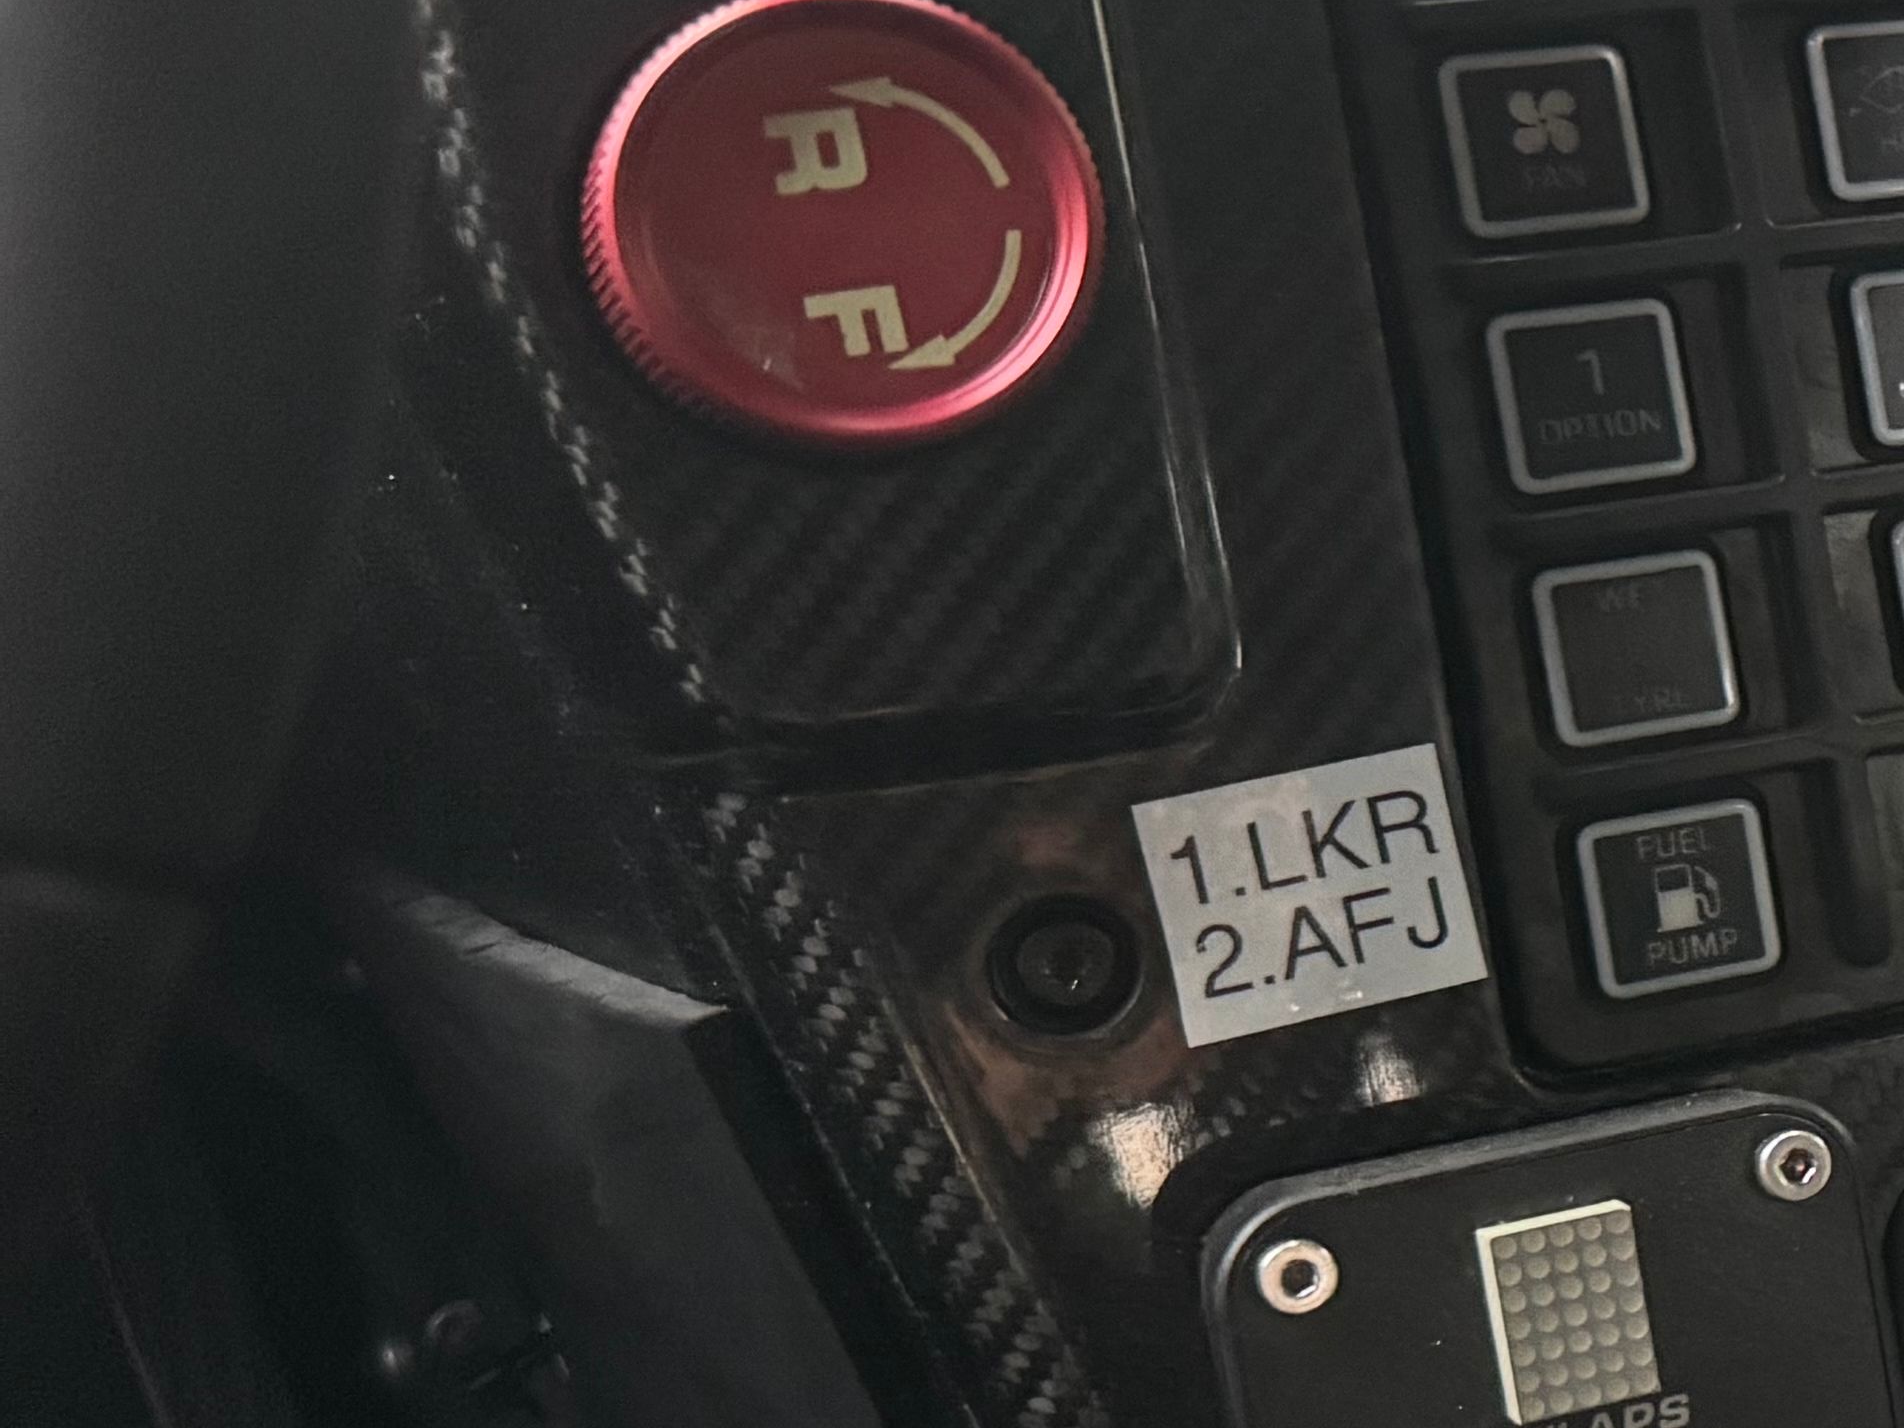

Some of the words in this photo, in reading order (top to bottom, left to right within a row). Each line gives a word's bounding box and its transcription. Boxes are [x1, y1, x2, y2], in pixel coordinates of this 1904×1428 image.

[763, 107, 869, 196] R
[803, 285, 909, 358] F
[1576, 348, 1605, 395] 1
[1538, 408, 1662, 445] OPTION
[1170, 790, 1439, 904] 1.LKR
[1636, 828, 1711, 859] FUEL
[1196, 876, 1448, 998] 2.AFJ
[1647, 928, 1738, 965] PUMP
